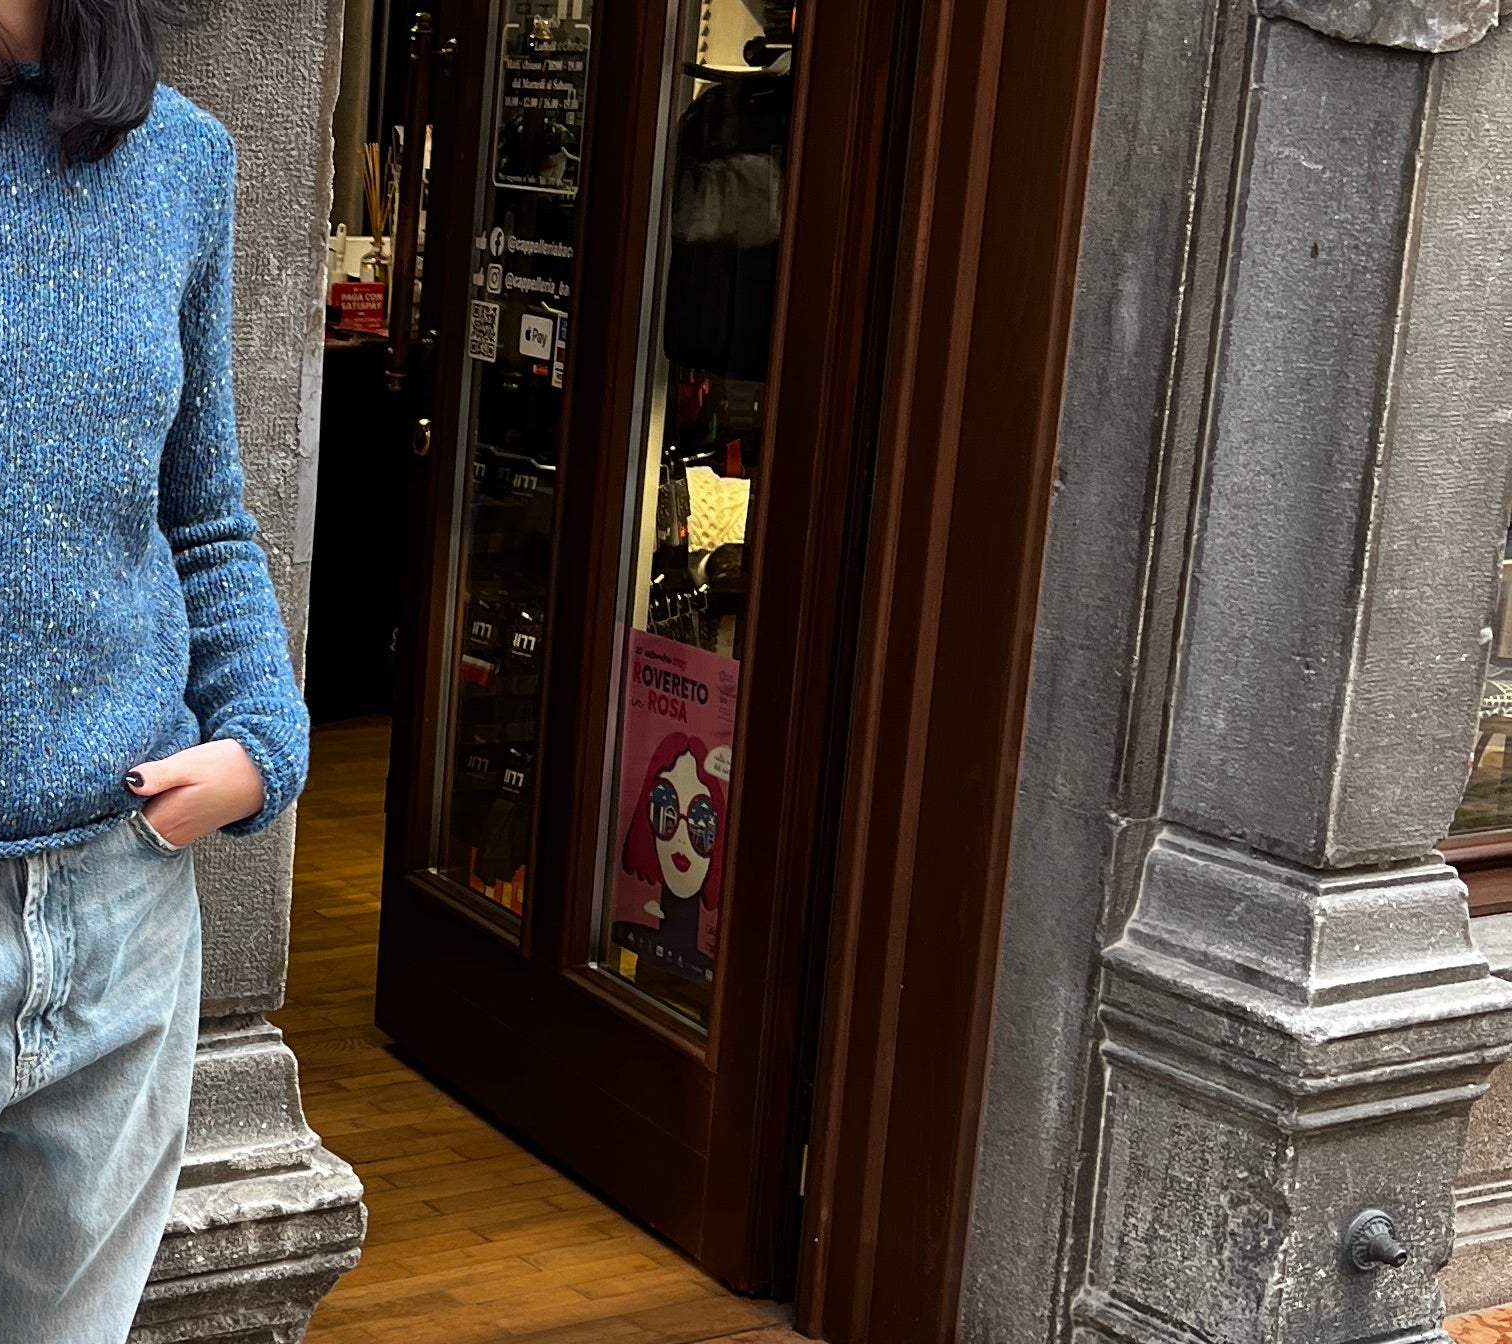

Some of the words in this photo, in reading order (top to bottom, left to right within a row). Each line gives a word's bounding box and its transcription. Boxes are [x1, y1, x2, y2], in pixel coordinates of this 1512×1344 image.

[532, 327, 548, 348] Pay
[632, 661, 709, 705] ROVERETO
[647, 690, 688, 724] ROSA
